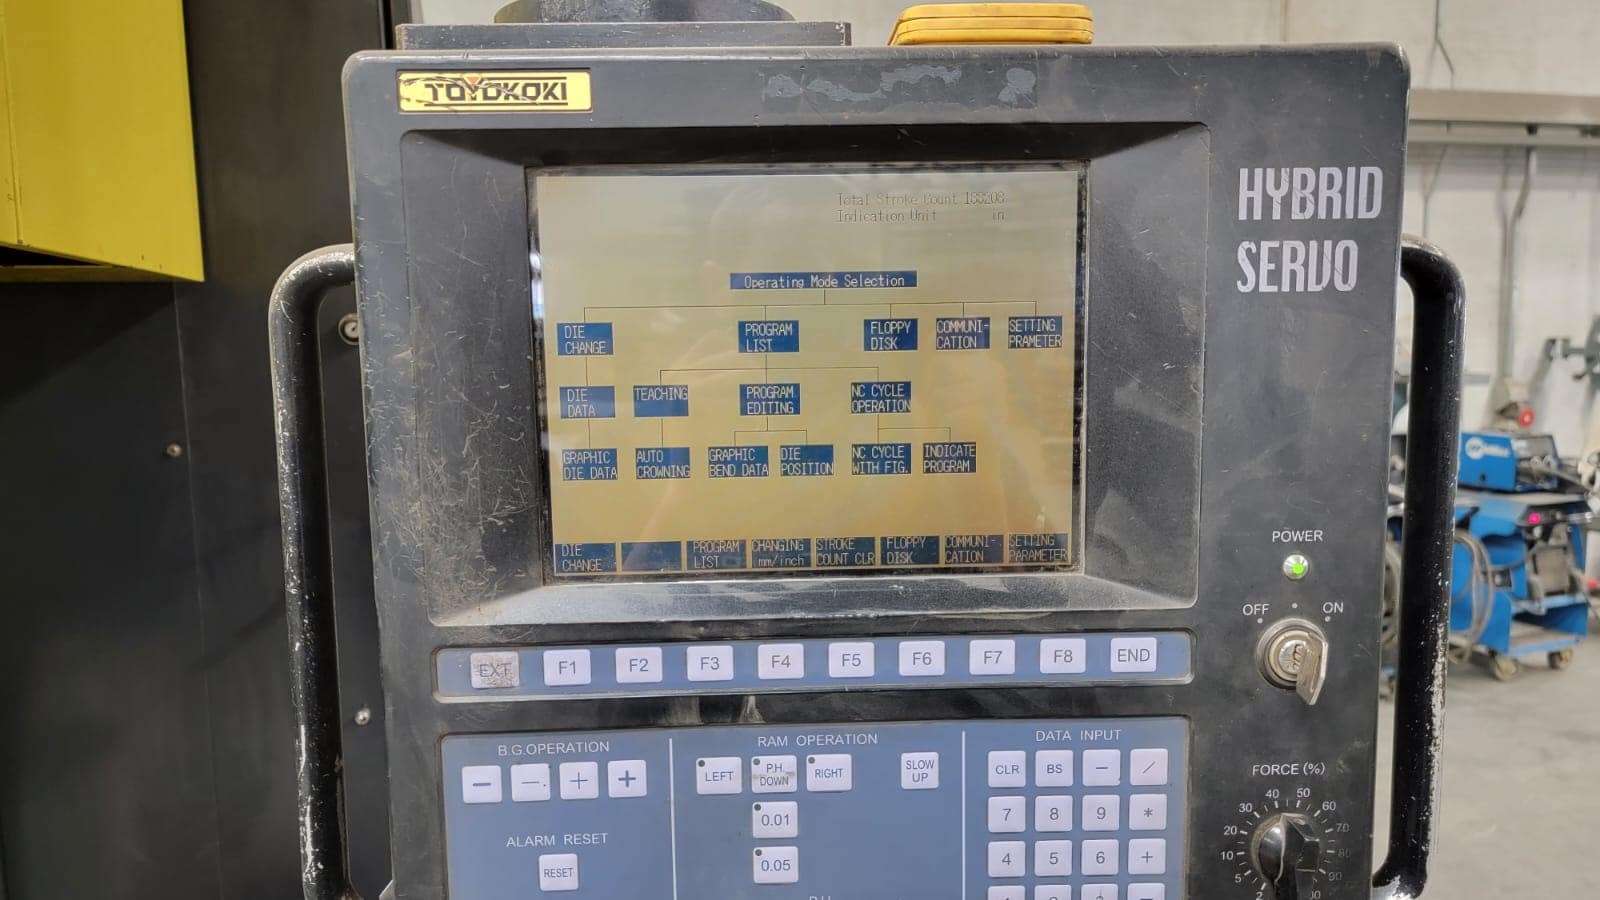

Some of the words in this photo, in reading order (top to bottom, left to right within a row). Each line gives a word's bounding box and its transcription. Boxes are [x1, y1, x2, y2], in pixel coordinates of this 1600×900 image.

[424, 82, 568, 101] TOYOKOKI
[836, 193, 869, 206] Total
[1238, 166, 1383, 220] HYBRID
[836, 209, 904, 223] Indication
[910, 209, 937, 221] Unit
[1236, 240, 1358, 293] SERVO
[744, 275, 804, 289] Operating
[810, 273, 838, 288] Mode
[844, 272, 905, 287] Selection
[564, 325, 585, 339] DIE
[745, 323, 793, 336] PROGRAM
[870, 321, 911, 335] FLOPPY
[936, 319, 990, 334] COMMUNI-
[1008, 319, 1056, 333] SETTING
[564, 341, 606, 355] CHANGE
[746, 339, 772, 352] LIST
[870, 337, 898, 350] DISK
[936, 336, 977, 349] CATION
[1008, 335, 1062, 348] PRAMETER
[567, 388, 588, 402] DIE
[634, 387, 689, 401] TEACHING
[746, 386, 794, 399] PROGRAM
[851, 384, 865, 397] NC
[871, 383, 904, 397] CYCLE
[567, 404, 595, 418] DATA
[746, 402, 794, 415] EDITING
[851, 399, 911, 413] OPERATION
[563, 450, 611, 465] GRAPHIC
[636, 449, 663, 463] AUTO
[708, 448, 755, 462] GRAPHIC
[781, 447, 801, 461] DIE
[852, 446, 865, 459] NC
[871, 445, 905, 459] CYCLE
[923, 444, 976, 458] INDICATE
[563, 466, 584, 480] DIE
[590, 465, 618, 479] DATA
[636, 464, 690, 478] CROWNING
[709, 463, 736, 477] BEND
[742, 462, 769, 476] DATA
[781, 462, 834, 476] POSITION
[852, 461, 879, 474] WITH
[884, 460, 909, 473] FIG.
[924, 459, 970, 473] PROGRAM
[886, 536, 927, 549] FLOPPY
[944, 535, 996, 548] COMMUNI-
[1008, 534, 1055, 547] SETTING
[1272, 530, 1324, 543] POWER
[561, 543, 582, 557] DIE
[693, 540, 740, 553] PROGRAM
[751, 538, 804, 552] CHANGING
[816, 537, 855, 551] STROKE
[694, 556, 720, 569] LIST
[758, 555, 804, 568] mm/inch
[816, 552, 849, 565] COUNT
[854, 551, 875, 565] CLR
[887, 551, 913, 564] DISK
[944, 550, 984, 563] CATION
[1009, 549, 1068, 562] PARAMETER
[562, 558, 603, 572] CHANGE
[1242, 603, 1270, 616] OFF
[1322, 602, 1344, 614] ON
[771, 655, 791, 669] F4
[841, 653, 862, 667] F5
[912, 652, 932, 666] F6
[983, 650, 1002, 664] F7
[1053, 649, 1073, 663] F8
[1117, 648, 1151, 663] END
[479, 662, 512, 678] EXT
[558, 661, 577, 675] F1
[629, 658, 649, 673] F2
[700, 656, 720, 671] F3
[757, 736, 788, 748] RAM
[796, 734, 878, 746] OPERATION
[1035, 730, 1072, 742] DATA
[1080, 729, 1122, 741] INPUT
[905, 759, 934, 770] SLOW
[995, 764, 1020, 775] CLR
[1046, 764, 1063, 774] BS
[1252, 763, 1300, 776] FORCE
[1303, 762, 1326, 775] (%)
[705, 771, 734, 782] LEFT
[814, 768, 844, 779] RIGHT
[912, 772, 929, 783] UP
[760, 776, 789, 787] DOWN
[1265, 789, 1280, 799] 40
[1296, 787, 1311, 798] 50
[1096, 806, 1106, 820] 9
[1238, 803, 1253, 813] 30
[1322, 801, 1336, 811] 60
[761, 814, 790, 827] 0.01
[1002, 808, 1012, 821] 7
[1049, 807, 1059, 820] 8
[1223, 825, 1238, 835] 20
[1335, 823, 1350, 833] 70
[506, 835, 556, 848] ALARM
[563, 833, 608, 845] RESET
[1001, 852, 1011, 866] 4
[1049, 852, 1059, 865] 5
[1095, 851, 1106, 864] 6
[1220, 851, 1234, 861] 10
[543, 867, 574, 878] RESET
[761, 859, 791, 872] 0.05
[1234, 873, 1242, 883] 5
